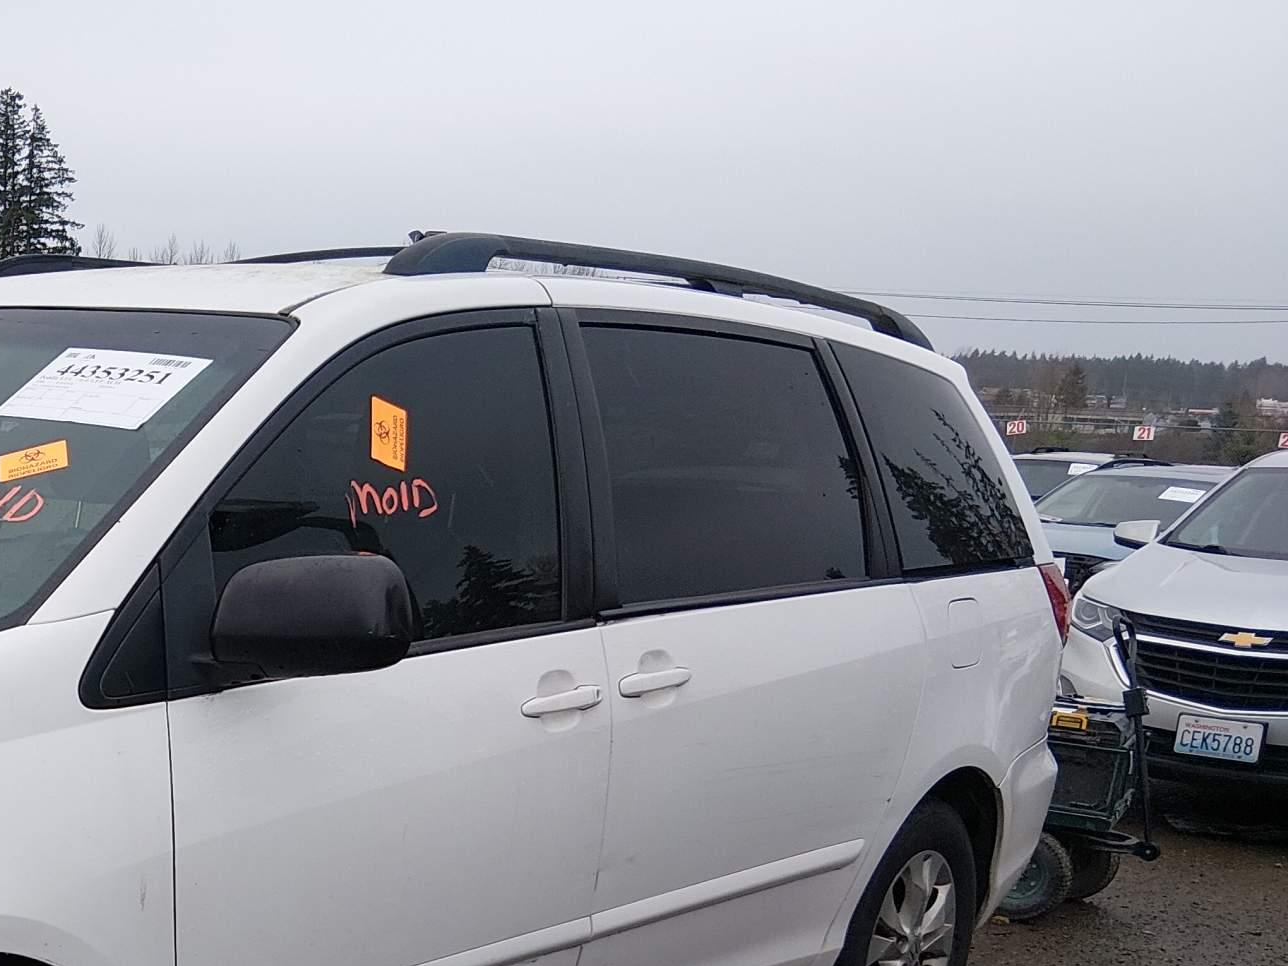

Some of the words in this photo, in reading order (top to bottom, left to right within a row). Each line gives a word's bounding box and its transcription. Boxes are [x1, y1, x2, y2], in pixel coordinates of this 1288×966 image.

[56, 363, 174, 385] 44353251
[1008, 421, 1025, 434] 20
[1137, 426, 1153, 440] 21
[1280, 433, 1288, 447] 2
[8, 457, 58, 474] BIOHAZARD
[1185, 722, 1230, 733] WASHINGTON
[1180, 729, 1254, 755] CEK5788
